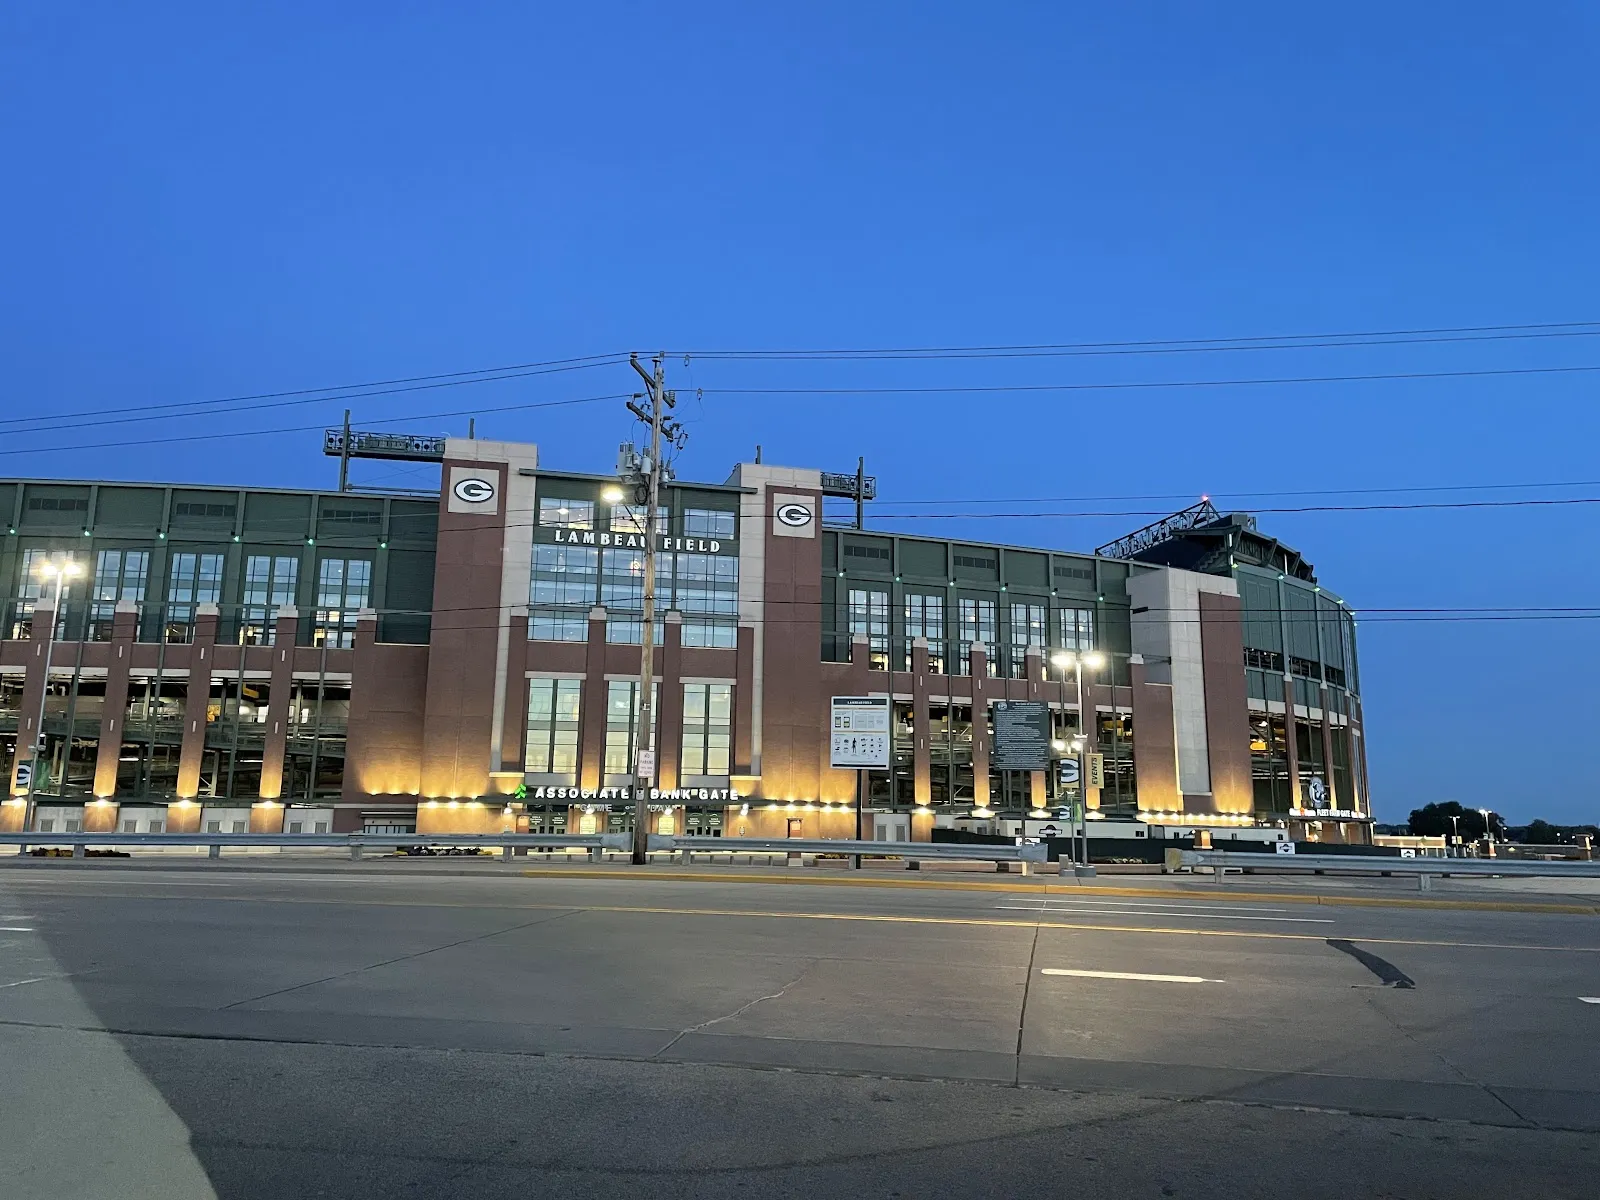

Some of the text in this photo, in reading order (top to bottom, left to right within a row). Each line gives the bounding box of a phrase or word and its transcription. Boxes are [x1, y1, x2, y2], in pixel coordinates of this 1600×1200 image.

[454, 479, 494, 503] G
[777, 504, 811, 527] G
[663, 537, 721, 553] FIELD
[535, 787, 739, 800] ASSOCIATE BANK GATE
